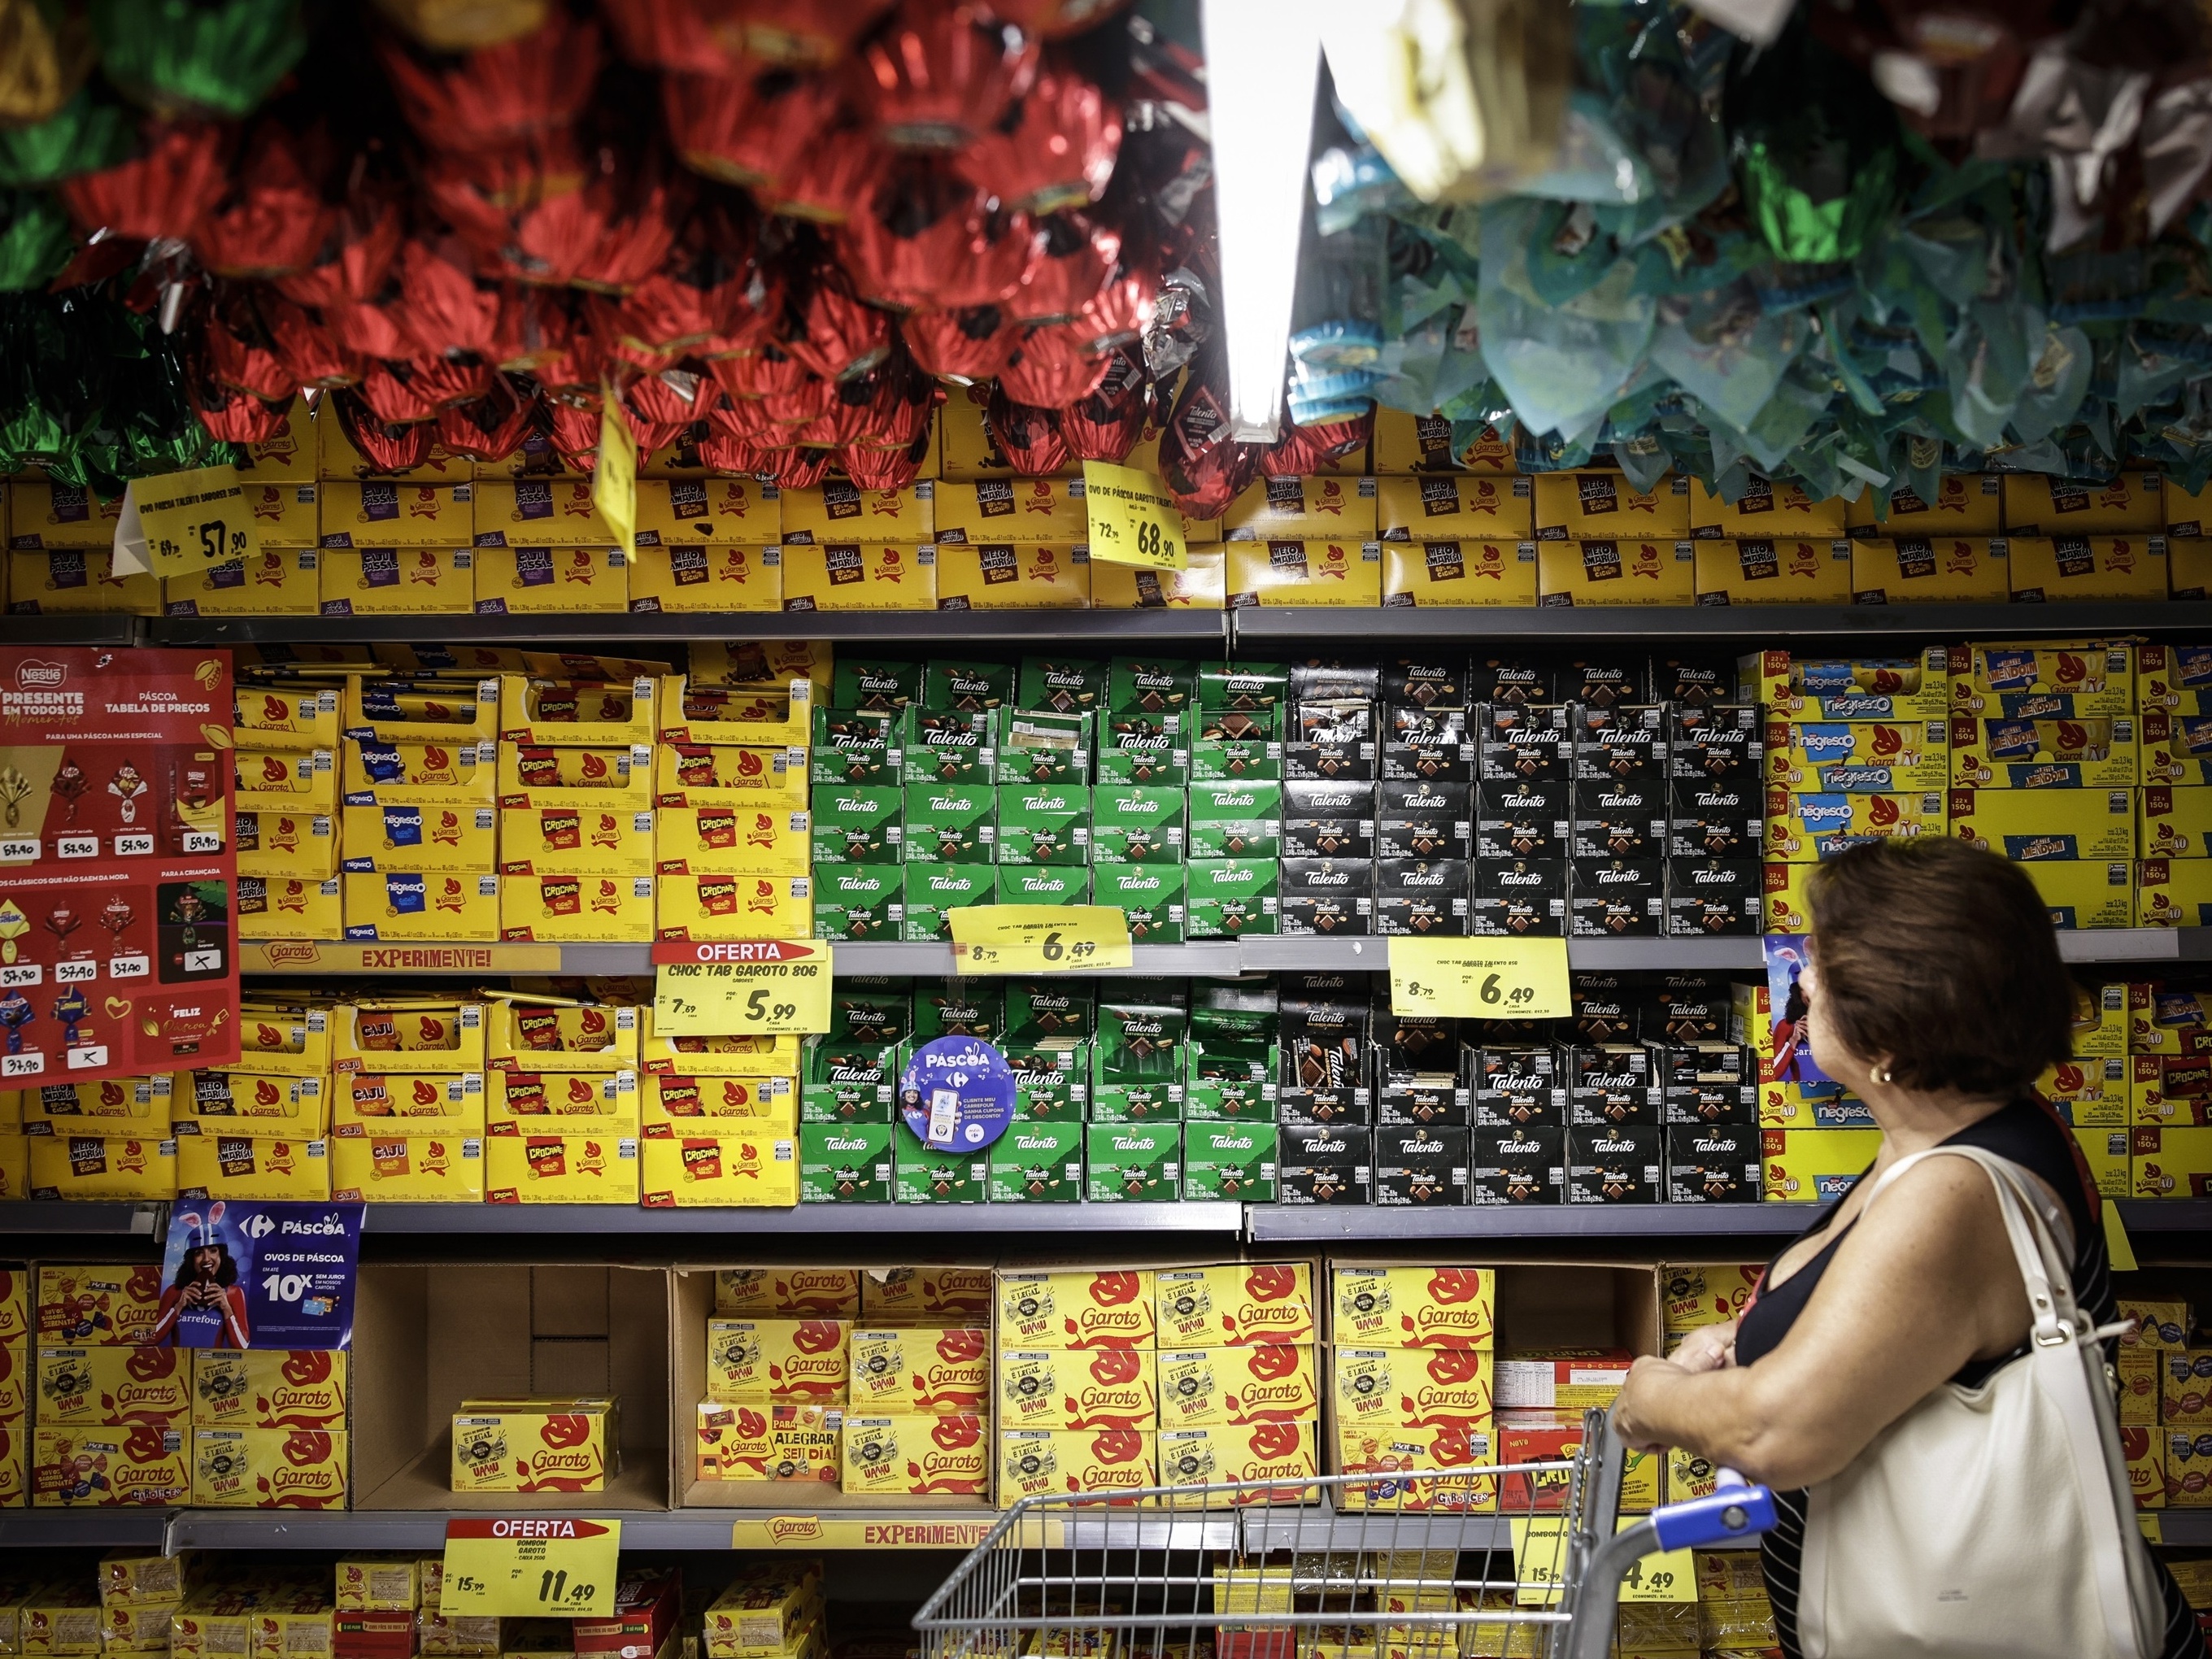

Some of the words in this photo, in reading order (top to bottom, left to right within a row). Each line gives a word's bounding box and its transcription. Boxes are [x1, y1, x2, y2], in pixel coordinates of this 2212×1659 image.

[1089, 485, 1100, 494] OVO
[1103, 486, 1110, 496] DE
[1113, 486, 1134, 500] PÁSCOA
[1134, 492, 1156, 504] GAROTO
[140, 503, 154, 514] OVO
[200, 520, 247, 558] 57,90
[1138, 521, 1174, 558] 68,90
[1583, 668, 1622, 679] Talento
[860, 676, 898, 690] Talento
[2, 692, 84, 704] PRESENTE
[139, 691, 177, 701] PÁSCOA
[2, 706, 20, 715] EM
[22, 705, 63, 715] TODOS
[64, 705, 83, 715] OS
[105, 703, 149, 713] TABELA
[150, 704, 166, 713] DE
[168, 703, 210, 714] PREÇOS
[84, 732, 112, 740] PÁSCOA
[419, 771, 450, 782] Garoto
[835, 798, 879, 812] Talento
[1115, 799, 1160, 813] Talento
[1308, 793, 1352, 807] Talento
[1598, 794, 1643, 807] Talento
[383, 816, 423, 826] negresco
[184, 868, 220, 877] CRIANÇADA
[9, 876, 46, 886] CLÁSSICOS
[63, 875, 78, 883] NÃO
[837, 877, 881, 890] Talento
[270, 945, 314, 960] Garoto
[697, 943, 782, 961] OFERTA
[973, 946, 997, 961] 8,79
[1043, 932, 1096, 961] 6,49
[362, 949, 491, 968] EXPERIMENTE!
[668, 964, 702, 977] CHOC
[707, 965, 731, 977] TAB
[736, 964, 788, 977] GAROTO
[792, 964, 818, 977] 80G
[1409, 982, 1434, 996] 8,79
[1480, 973, 1535, 1006] 6,49
[173, 1008, 201, 1017] FELIZ
[672, 999, 696, 1014] 7,69
[744, 990, 796, 1022] 5,99
[521, 1017, 556, 1030] CROCANTE
[576, 1034, 607, 1045] Garoto
[925, 1052, 990, 1068] PÁSCOA
[830, 1066, 882, 1082] Talento
[1209, 1134, 1253, 1149] Talento
[1302, 1139, 1347, 1152] Talento
[1592, 1139, 1636, 1152] Talento
[372, 1144, 407, 1159] CAJU
[685, 1147, 721, 1160] CROCANTE
[281, 1220, 345, 1235] PÁSCOA
[307, 1252, 344, 1262] PÁSCOA
[1353, 1282, 1377, 1294] LEGAL
[1081, 1306, 1141, 1328] Garoto
[785, 1355, 842, 1374] Garoto
[272, 1387, 332, 1408] Garoto
[1082, 1386, 1141, 1407] Garoto
[773, 1419, 796, 1429] PARA
[470, 1430, 493, 1443] LEGAL
[774, 1432, 834, 1444] ALEGRAR
[1509, 1439, 1528, 1448] NOVO
[532, 1450, 590, 1467] Garoto
[783, 1448, 805, 1461] SEU
[923, 1451, 982, 1470] Garoto
[472, 1462, 499, 1478] UAAAU
[492, 1520, 576, 1537] OFERTA
[773, 1519, 816, 1535] Garoto
[457, 1577, 485, 1592] 15,99
[539, 1570, 595, 1603] 11,49
